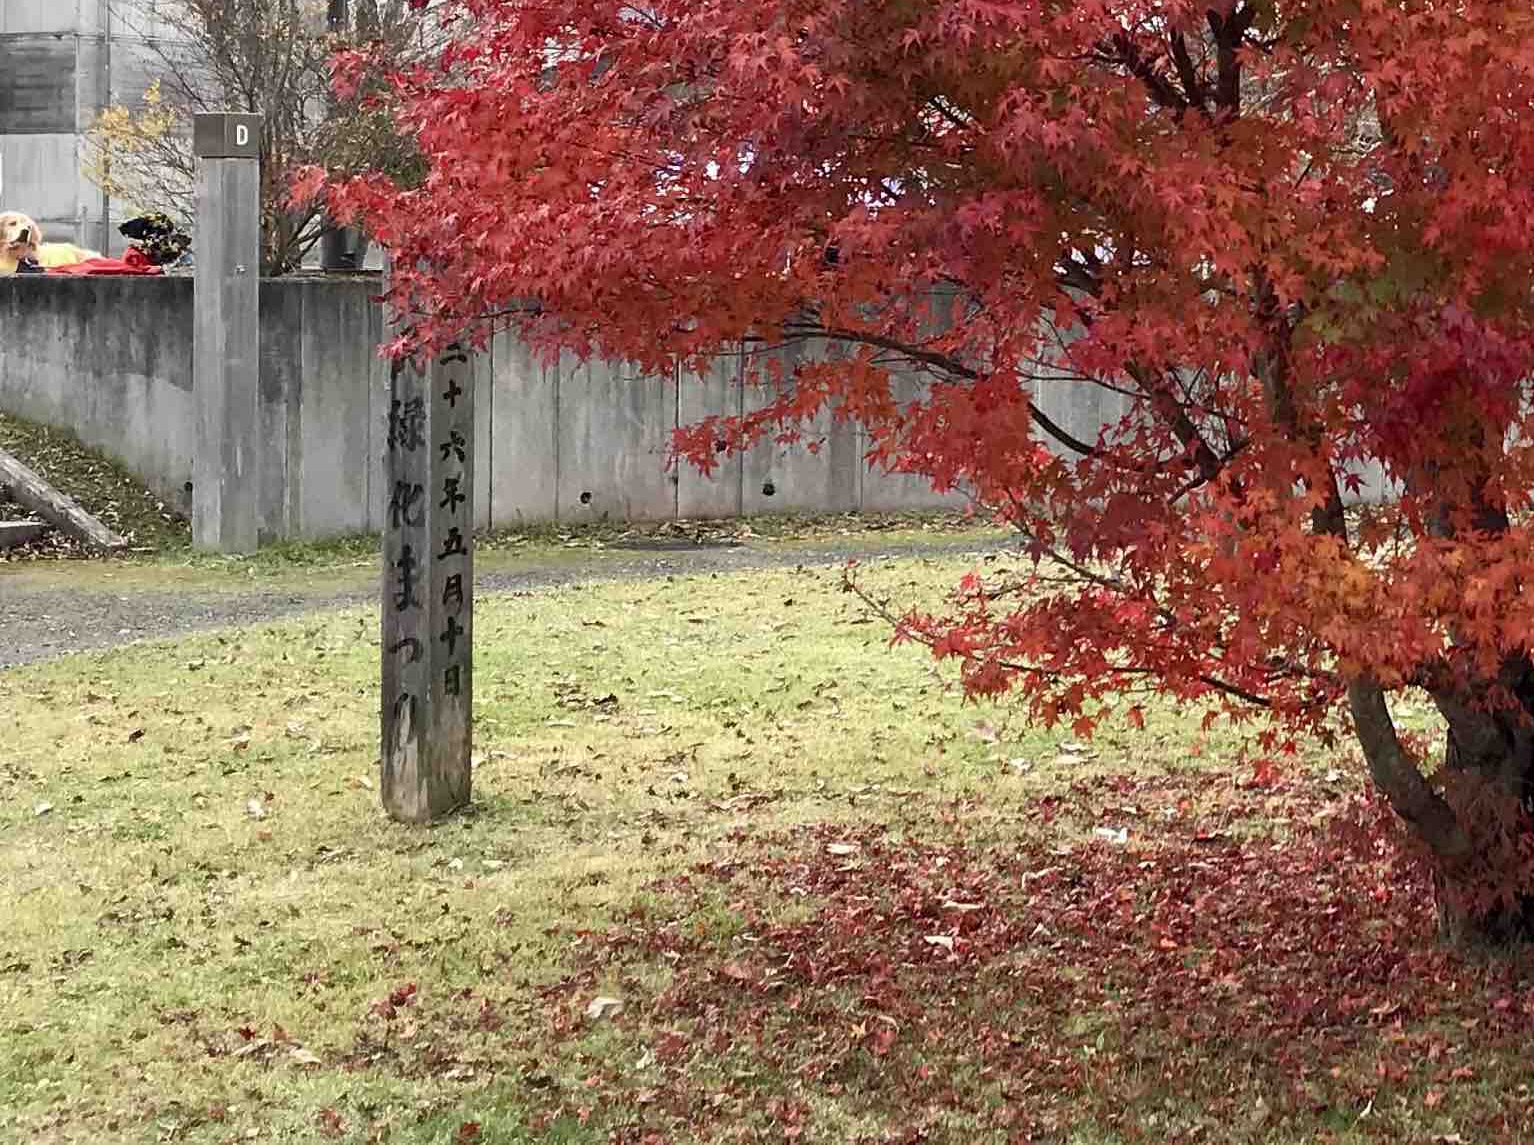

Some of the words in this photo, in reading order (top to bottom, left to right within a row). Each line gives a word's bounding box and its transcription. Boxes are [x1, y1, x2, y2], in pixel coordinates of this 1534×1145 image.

[236, 124, 249, 146] D
[387, 358, 426, 747] 緑化まつり
